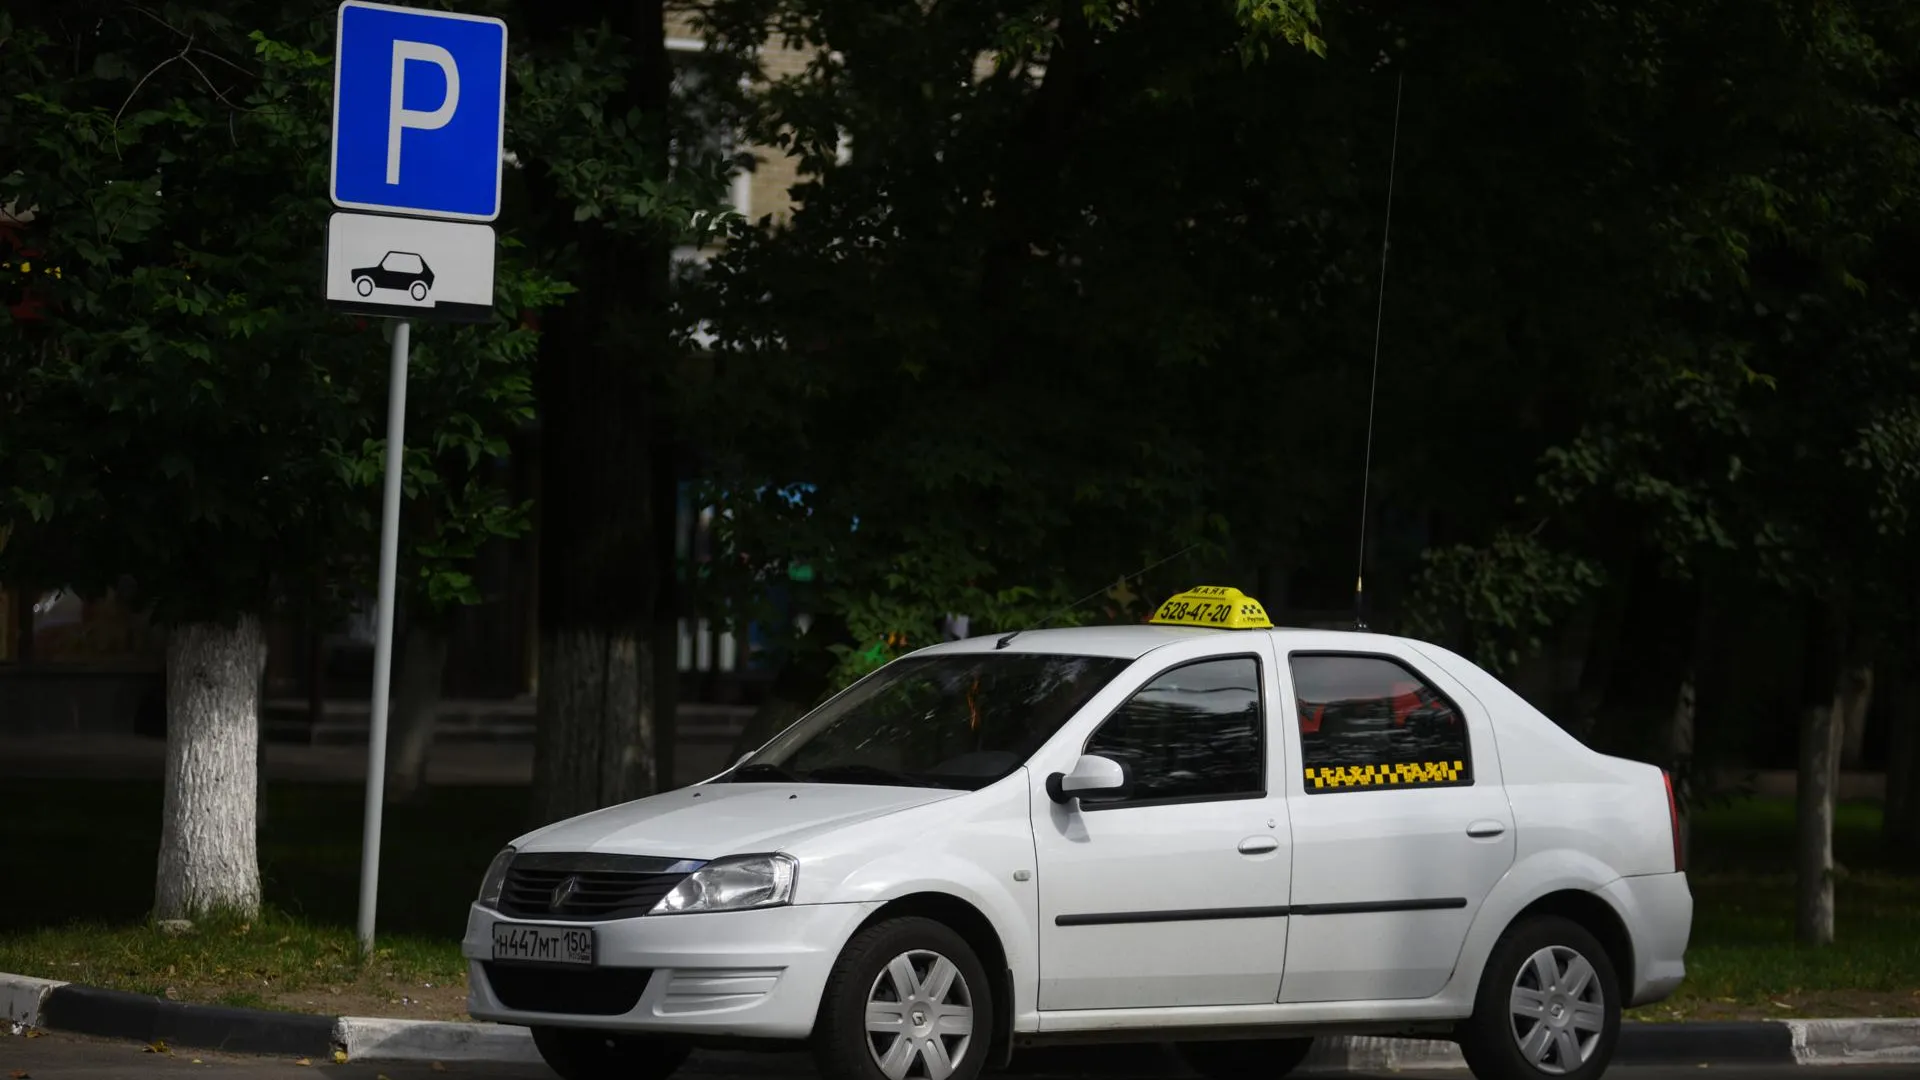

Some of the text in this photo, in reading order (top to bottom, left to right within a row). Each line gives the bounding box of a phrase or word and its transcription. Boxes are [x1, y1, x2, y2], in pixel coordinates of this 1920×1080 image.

[386, 39, 460, 185] P
[1192, 586, 1229, 596] МАЯК
[1160, 601, 1232, 623] 528-47-20
[1325, 766, 1373, 785] TAXI
[1401, 761, 1448, 782] TAXI
[499, 928, 587, 958] Н447МТ 150
